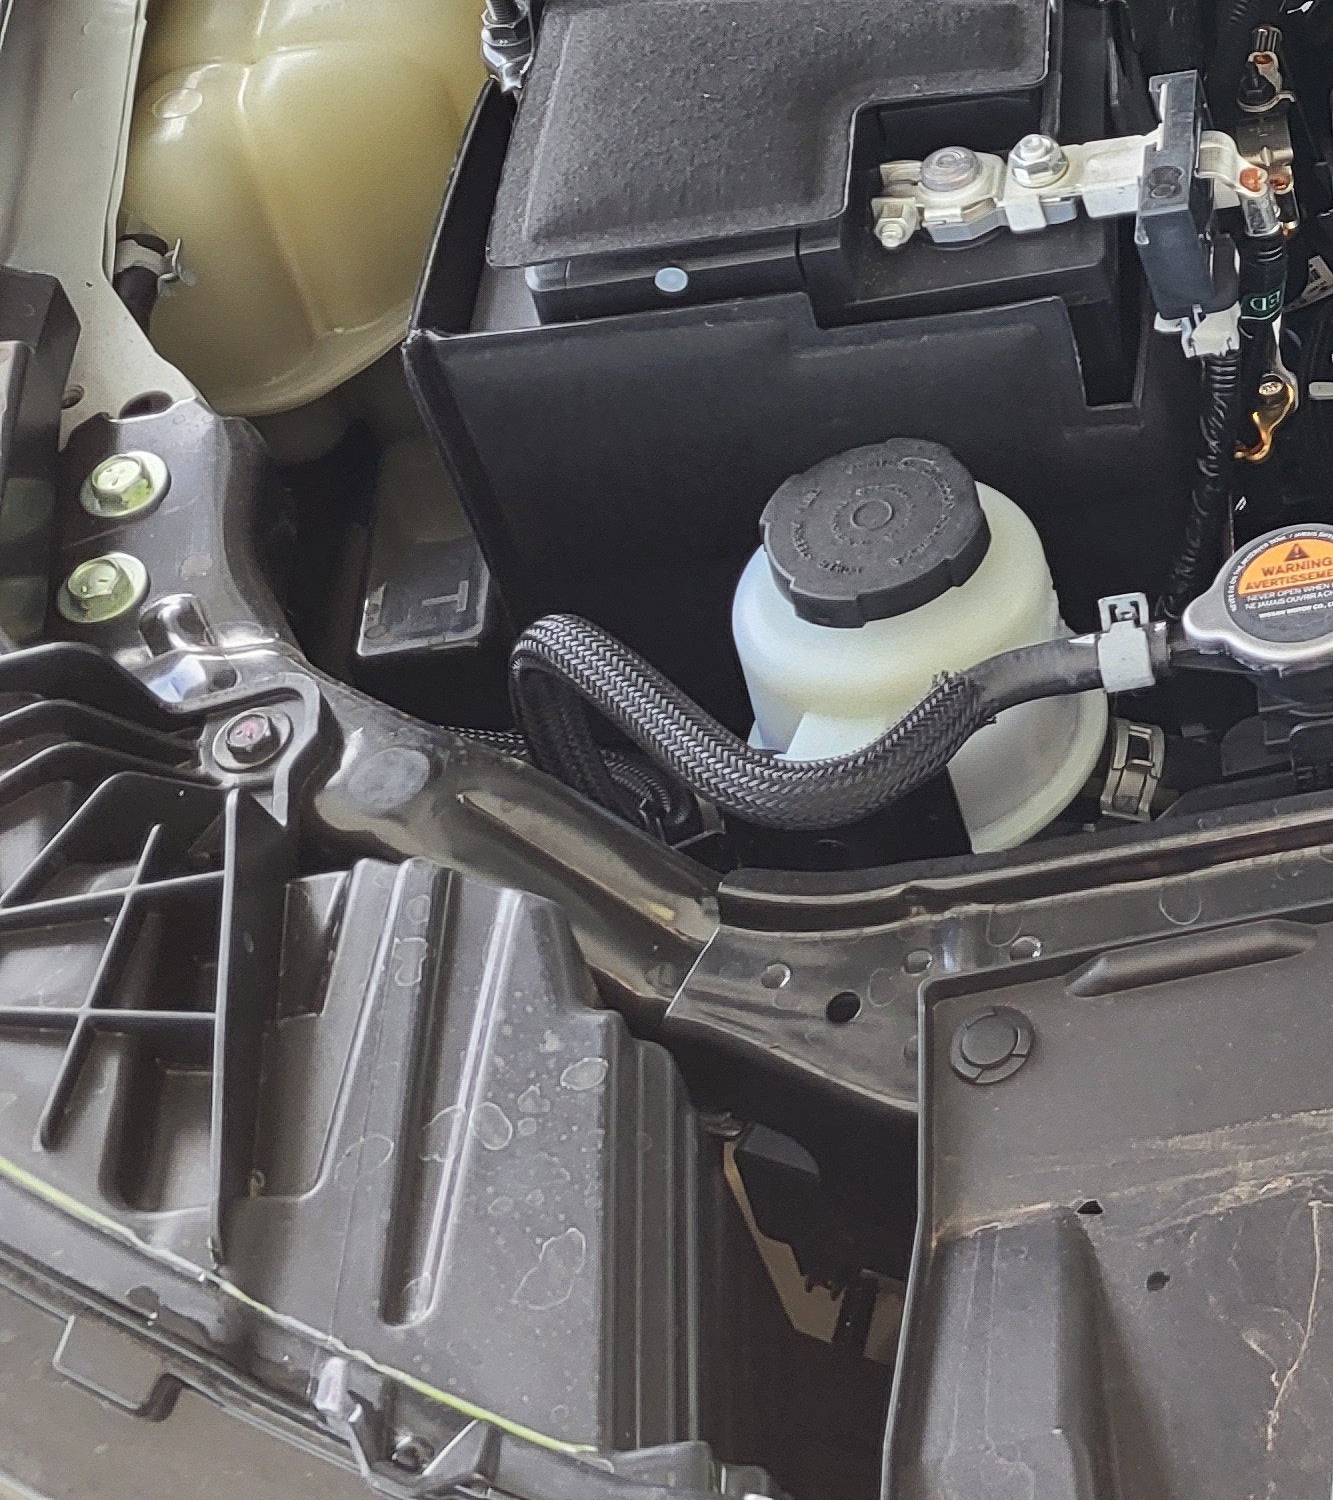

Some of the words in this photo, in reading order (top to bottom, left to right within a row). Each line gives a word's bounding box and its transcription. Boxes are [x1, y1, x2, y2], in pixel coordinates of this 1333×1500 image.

[1261, 556, 1333, 578] WARNING
[1245, 603, 1257, 611] NE
[1257, 598, 1286, 609] JAMAIS
[1286, 593, 1317, 604] OUVRIR
[1246, 591, 1276, 602] NEVER
[1276, 587, 1302, 597] OPEN
[1302, 583, 1331, 594] WHEN
